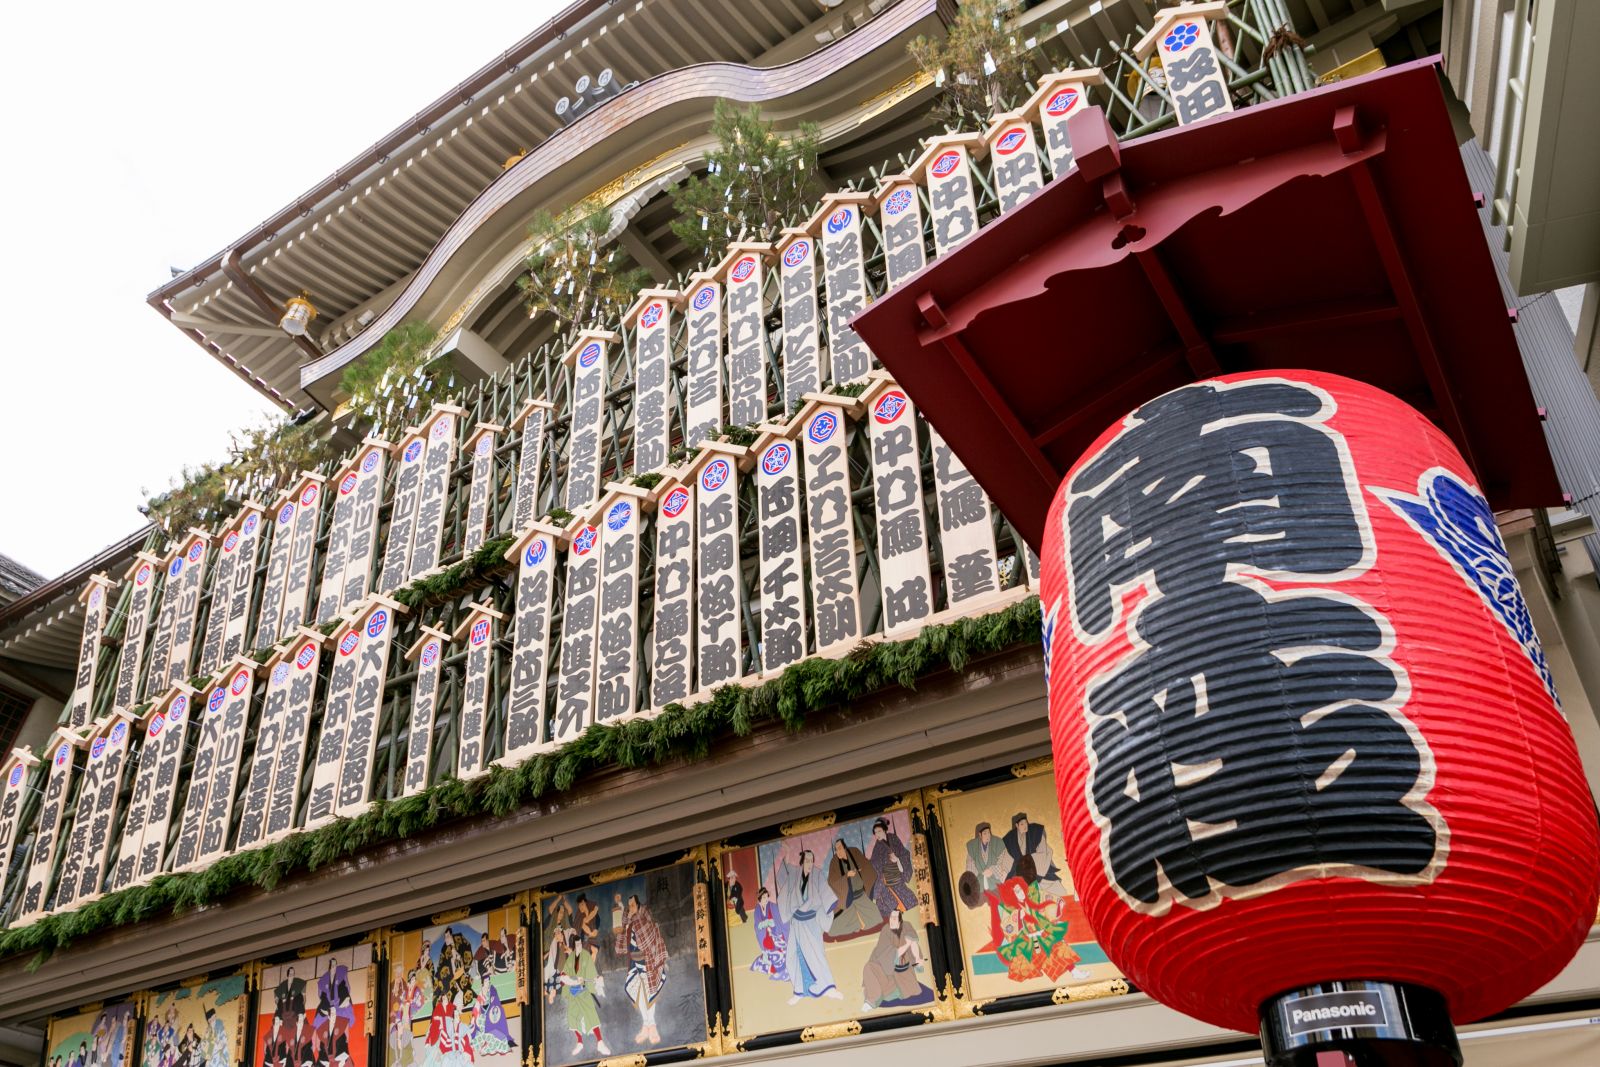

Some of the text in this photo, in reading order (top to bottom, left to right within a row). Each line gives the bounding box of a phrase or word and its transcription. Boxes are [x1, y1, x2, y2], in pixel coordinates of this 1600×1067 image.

[1168, 47, 1228, 125] 坂田
[886, 214, 923, 289] 片岡
[932, 176, 974, 256] 中村
[637, 327, 666, 474] 片岡愛之助
[410, 441, 449, 577] 松本幸四郎
[557, 557, 598, 739] 片岡進之介
[598, 533, 634, 719] 片岡松之助
[1292, 1001, 1377, 1024] Panasonic
